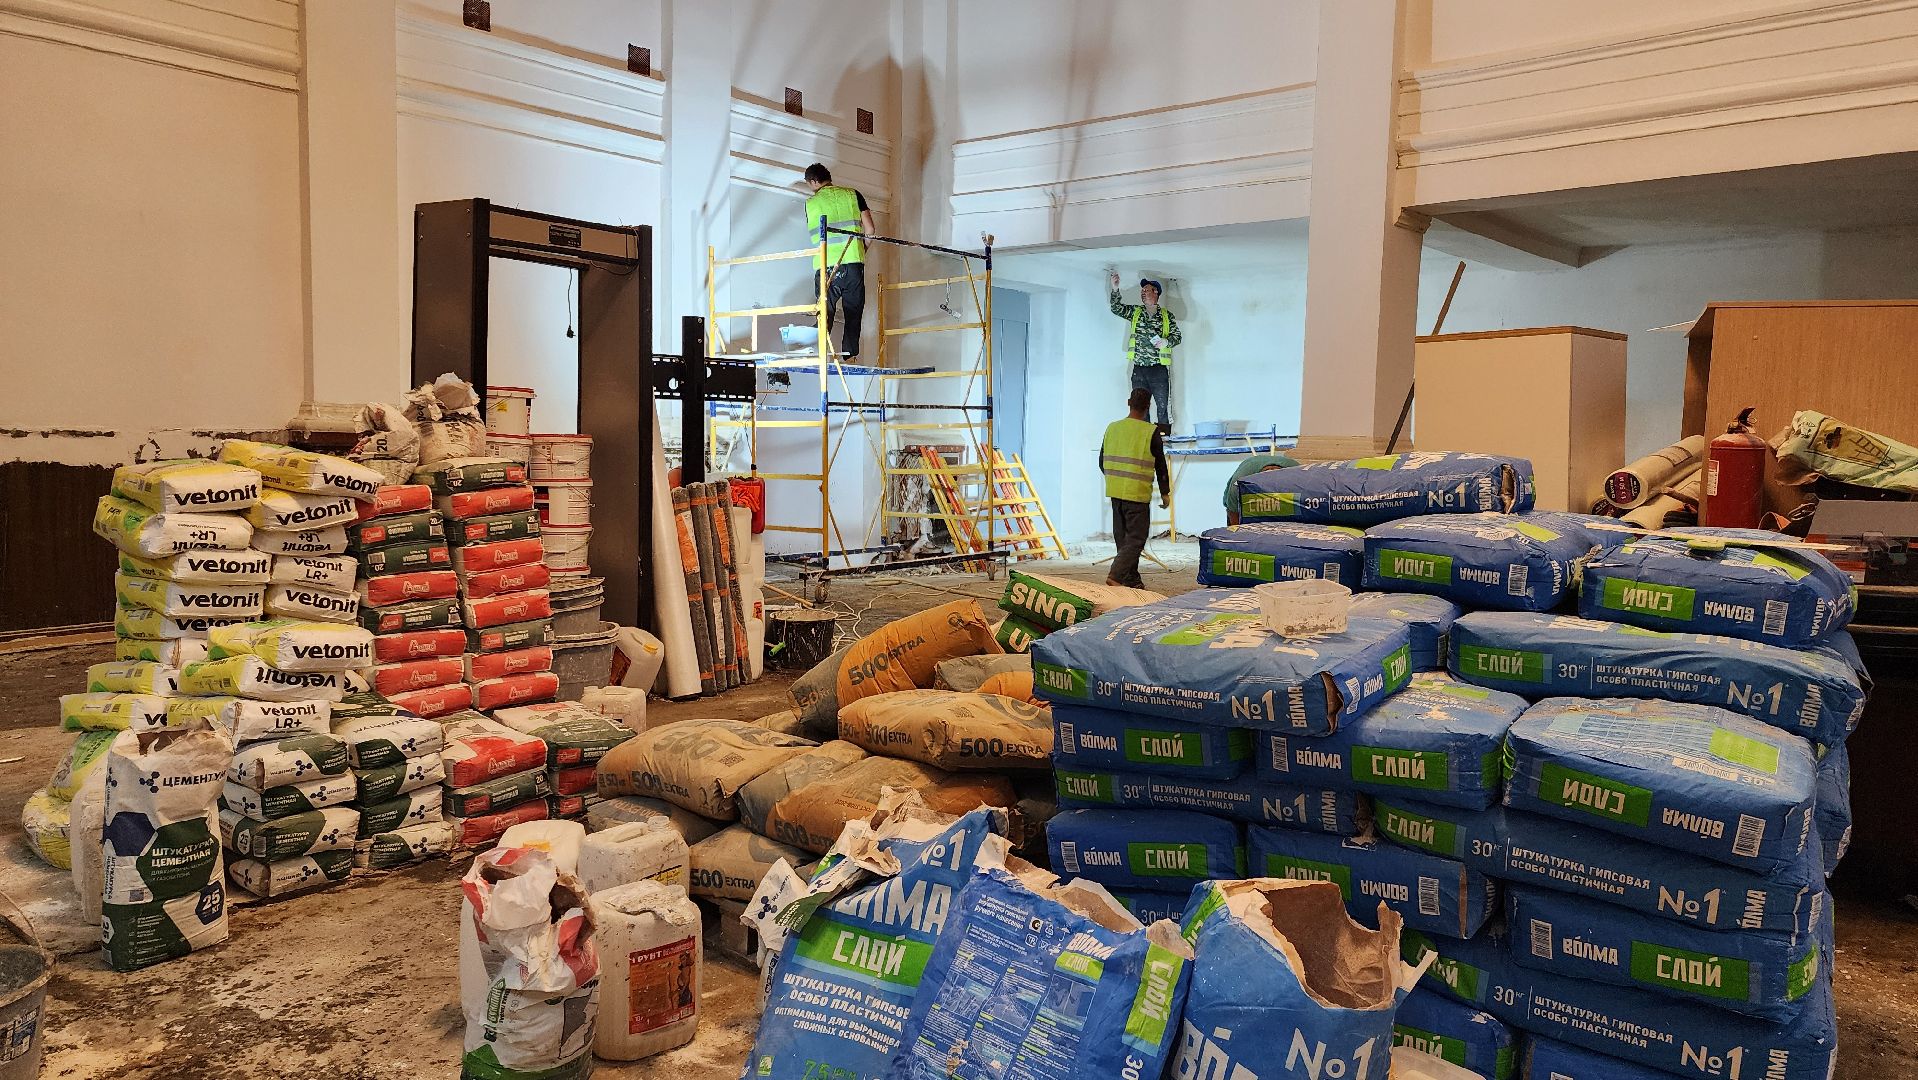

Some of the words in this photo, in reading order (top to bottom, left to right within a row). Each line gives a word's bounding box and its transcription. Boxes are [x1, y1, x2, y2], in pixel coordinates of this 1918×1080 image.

[174, 484, 258, 506] vetonit
[1249, 496, 1281, 514] СЛОЙ
[1332, 503, 1354, 512] ОСОБО
[1356, 500, 1404, 510] ПЛАСТИЧНАЯ
[1333, 491, 1379, 504] ШТУКАТУРКА
[1380, 490, 1419, 502] ГИПСОВАЯ
[1428, 484, 1467, 507] №1
[1479, 477, 1493, 511] ВОЛМА
[276, 499, 352, 526] vetonit
[190, 530, 217, 542] LR+
[282, 541, 331, 551] vetonit
[299, 532, 320, 542] LR+
[187, 558, 268, 574] vetonit
[293, 557, 344, 572] vetonit
[305, 569, 329, 580] LR+
[1225, 556, 1261, 577] СЛОЙ
[1394, 556, 1434, 580] СЛОЙ
[1459, 567, 1501, 587] ВОЛМА
[178, 592, 260, 608] vetonit
[285, 589, 358, 614] vetonit
[1010, 580, 1077, 626] UNIS
[1622, 588, 1674, 613] СЛОЙ
[1704, 600, 1755, 624] ВОЛМА
[292, 642, 370, 659] vetonit
[847, 652, 889, 686] 500
[1390, 651, 1407, 682] СЛОЙ
[1478, 651, 1524, 676] СЛОЙ
[1596, 663, 1665, 680] ШТУКАТУРКА
[1666, 669, 1722, 686] ГИПСОВАЯ
[255, 666, 337, 689] vetonit
[1363, 673, 1384, 699] ВОЛМА
[1596, 675, 1627, 686] ОСОБО
[1628, 677, 1700, 694] ПЛАСТИЧНАЯ
[1124, 683, 1176, 701] ШТУКАТУРКА
[1177, 688, 1221, 702] ГИПСОВАЯ
[1124, 694, 1149, 705] ОСОБО
[1149, 696, 1204, 711] ПЛАСТИЧНАЯ
[1727, 680, 1784, 716] №1
[260, 703, 318, 716] vetonit
[1230, 689, 1276, 722] №1
[1291, 684, 1307, 729] ВОЛМА
[1799, 683, 1823, 729] ВОЛМА
[275, 717, 303, 729] LR+
[865, 724, 888, 747] 500
[888, 731, 913, 746] EXTRA
[959, 736, 1002, 759] 500
[1005, 742, 1045, 756] EXTRA
[1079, 731, 1118, 751] ВОЛМА
[1140, 731, 1184, 759] СЛОЙ
[1296, 746, 1342, 769] ВОЛМА
[1371, 752, 1426, 780] СЛОЙ
[664, 784, 690, 799] EXTRA
[1066, 775, 1100, 798] СЛОЙ
[1152, 783, 1205, 799] ШТУКАТУРКА
[1206, 789, 1252, 803] ГИПСОВАЯ
[1563, 778, 1627, 816] СЛОЙ
[1153, 795, 1179, 804] ОСОБО
[1180, 797, 1235, 811] ПЛАСТИЧНАЯ
[1262, 792, 1308, 824] №1
[1321, 788, 1337, 833] ВОЛМА
[774, 818, 810, 847] 500
[1387, 812, 1435, 849] СЛОЙ
[1662, 807, 1725, 839] ВОЛМА
[152, 838, 215, 857] ШТУКАТУРКА
[240, 833, 248, 846] 25
[151, 849, 211, 868] ЦЕМЕНТНАЯ
[1084, 848, 1123, 867] ВОЛМА
[1145, 844, 1190, 871] СЛОЙ
[1511, 847, 1586, 876] ШТУКАТУРКА
[1588, 868, 1651, 891] ГИПСОВАЯ
[690, 868, 724, 889] 500
[725, 876, 756, 890] EXTRA
[1510, 858, 1547, 879] ОСОБО
[1548, 870, 1625, 897] ПЛАСТИЧНАЯ
[203, 889, 221, 911] 25
[1360, 880, 1410, 904] ВОЛМА
[838, 876, 952, 936] ОЛМА
[1657, 885, 1722, 925] №1
[1740, 890, 1767, 929] ОЛМА
[831, 929, 908, 978] СЛОЙ
[1065, 930, 1117, 960] ВОЛМА
[1562, 936, 1620, 967] ВОЛМА
[1656, 952, 1722, 989] СЛОЙ
[783, 972, 863, 1004] ШТУКАТУРКА
[789, 989, 828, 1008] ОСОБО
[1146, 960, 1174, 1023] СЛОЙ
[774, 1006, 829, 1025] ОПТИМАЛЬНА
[829, 1014, 849, 1028] ДЛЯ
[1533, 1007, 1569, 1025] ОСОБО
[1570, 1017, 1648, 1049] ПЛАСТИЧНАЯ
[1534, 994, 1609, 1024] ШТУКАТУРКА
[1610, 1019, 1673, 1045] ГИПСОВАЯ
[793, 1020, 837, 1039] СЛОЖНЫХ
[838, 1028, 891, 1055] ОСНОВАНИЙ
[1285, 1027, 1377, 1080] №1
[1680, 1040, 1743, 1080] №1
[1760, 1048, 1790, 1080] ЛМА
